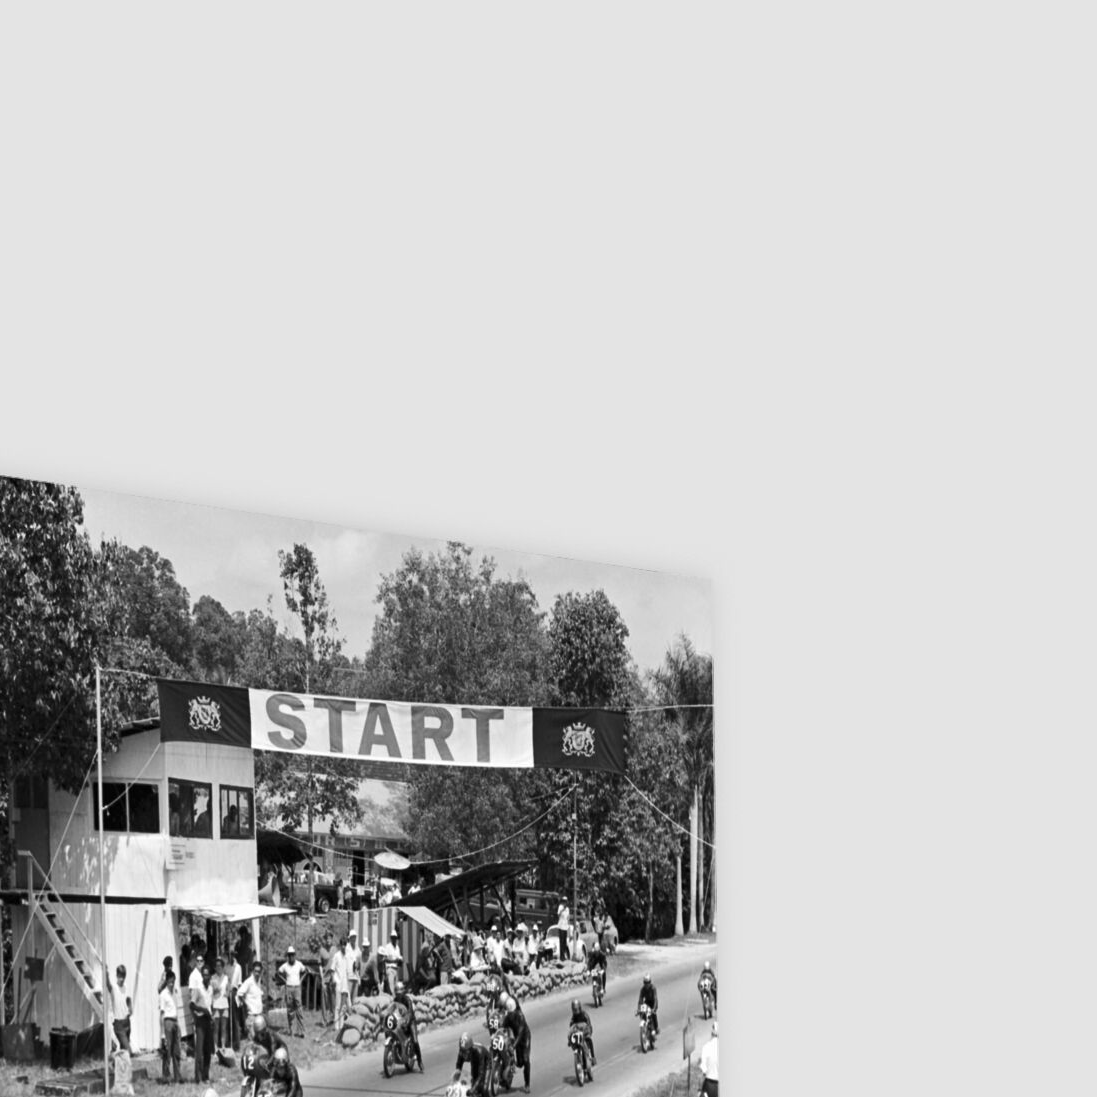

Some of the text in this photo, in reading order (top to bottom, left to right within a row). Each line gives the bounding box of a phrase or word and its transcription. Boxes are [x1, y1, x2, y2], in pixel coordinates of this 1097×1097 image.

[266, 693, 504, 763] START
[387, 1015, 394, 1029] 6
[493, 1037, 504, 1051] 50
[243, 1055, 254, 1069] 12
